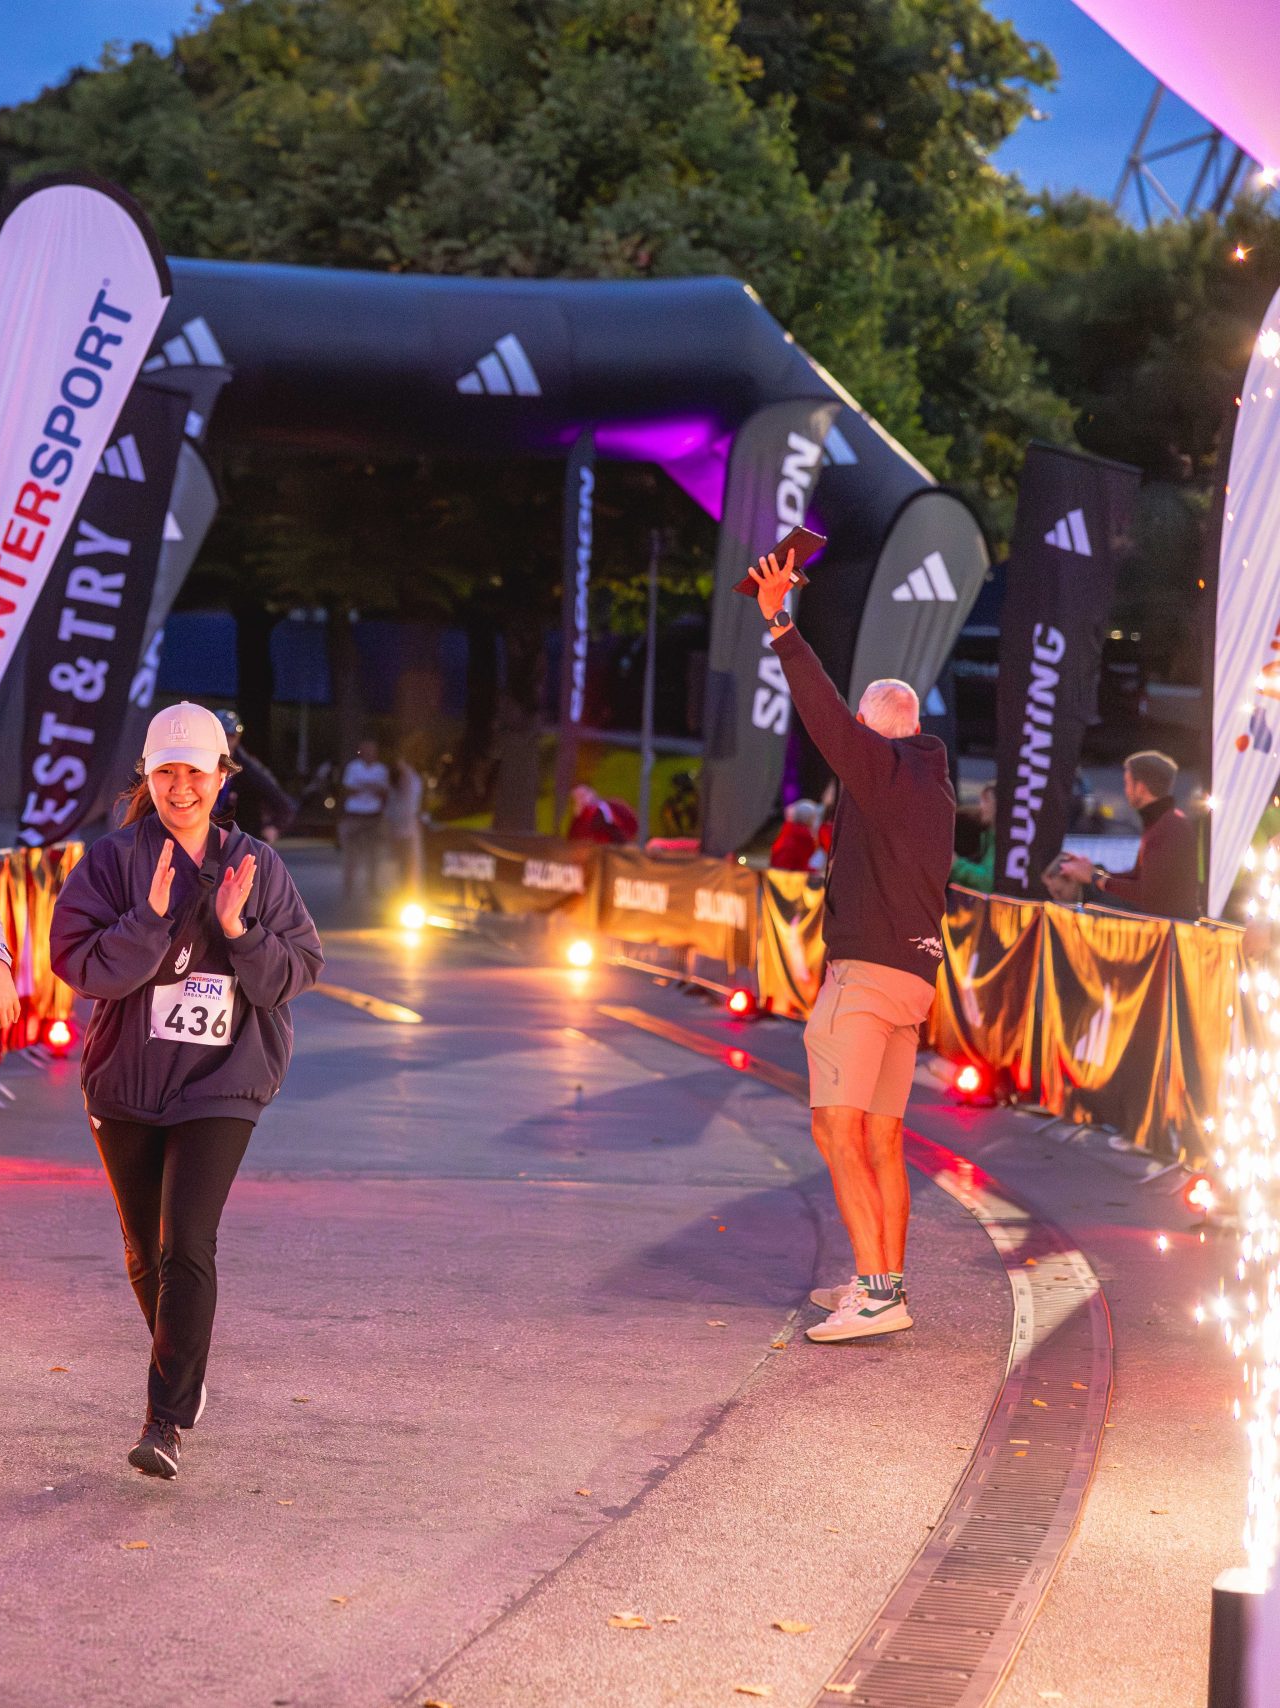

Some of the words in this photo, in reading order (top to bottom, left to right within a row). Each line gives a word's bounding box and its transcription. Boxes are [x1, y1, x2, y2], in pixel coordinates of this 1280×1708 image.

[57, 518, 132, 642] TRY
[48, 655, 110, 703] &
[174, 946, 189, 969] NIKE
[184, 981, 223, 996] RUN
[164, 1003, 227, 1038] 436
